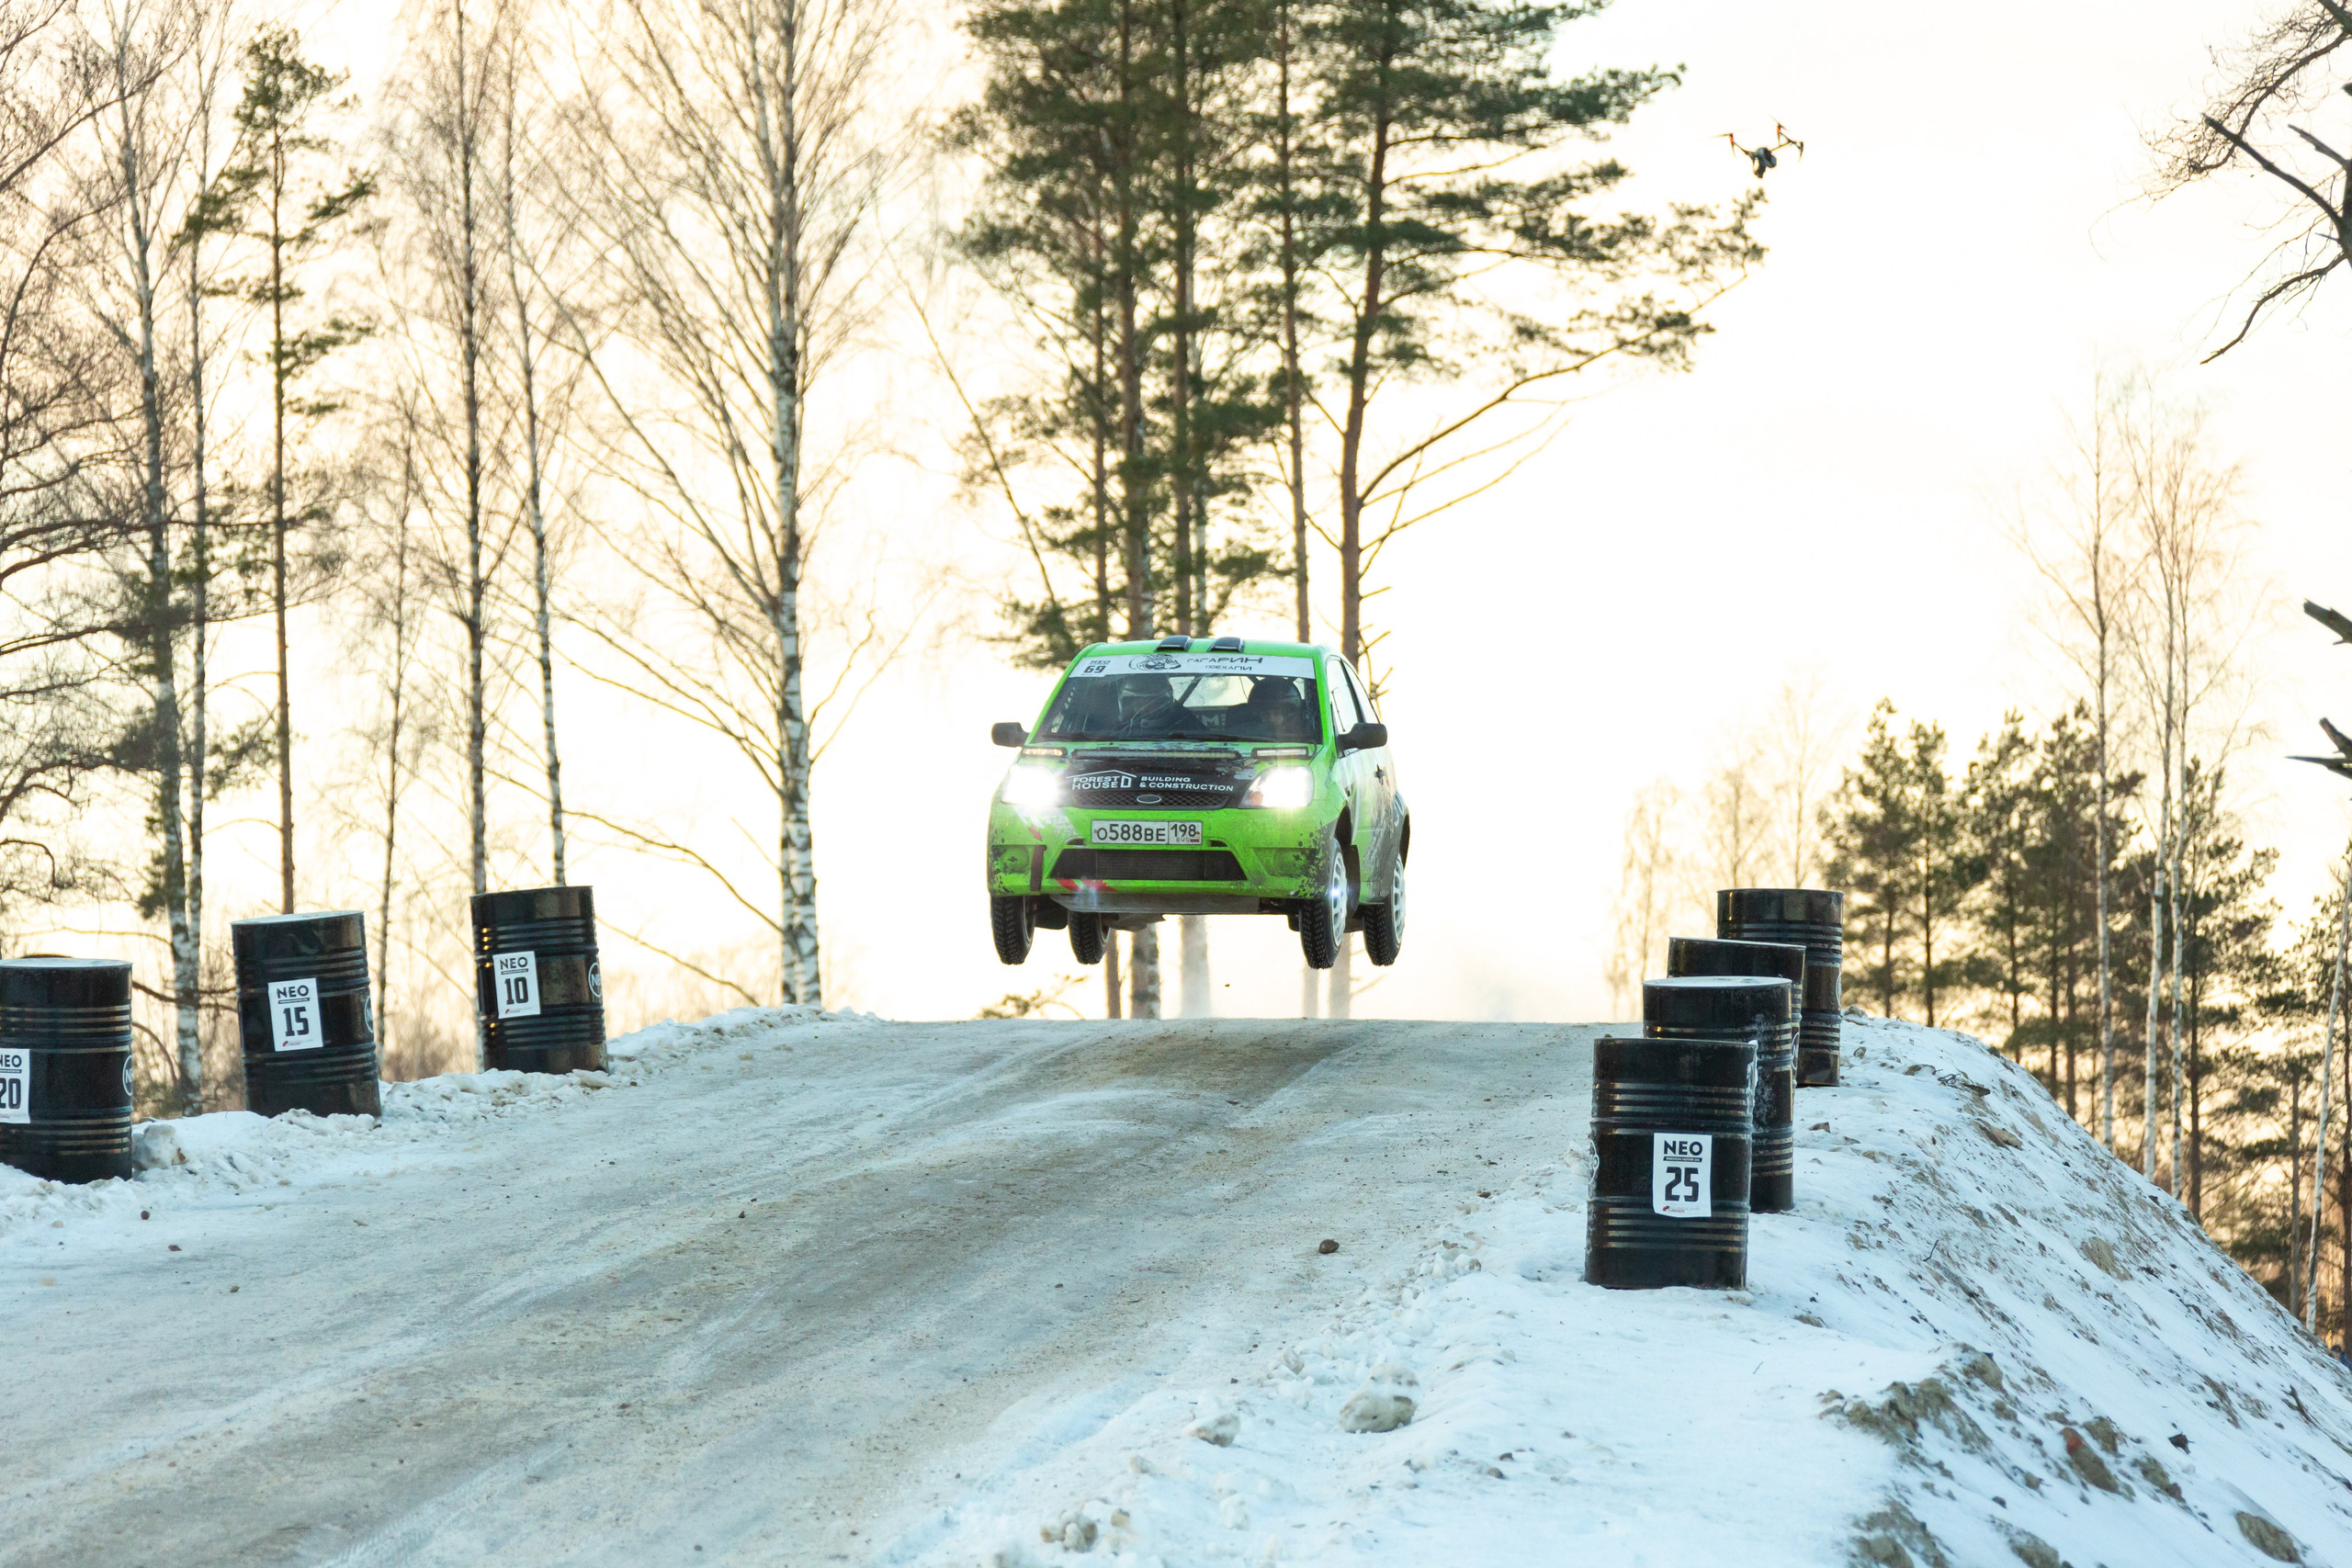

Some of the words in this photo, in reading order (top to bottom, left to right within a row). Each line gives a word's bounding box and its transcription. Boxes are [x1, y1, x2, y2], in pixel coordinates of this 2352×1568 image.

[1083, 665, 1106, 673] 69
[1072, 782, 1118, 790] HOUSE
[1073, 775, 1120, 784] FOREST
[1148, 782, 1234, 792] CONSTRUCTION
[1170, 823, 1197, 838] 198
[500, 956, 528, 970] NEO
[277, 985, 310, 998] NEO
[504, 976, 528, 1006] 10
[283, 1006, 310, 1037] 15
[1664, 1140, 1703, 1156] NEO
[1665, 1166, 1700, 1202] 25
